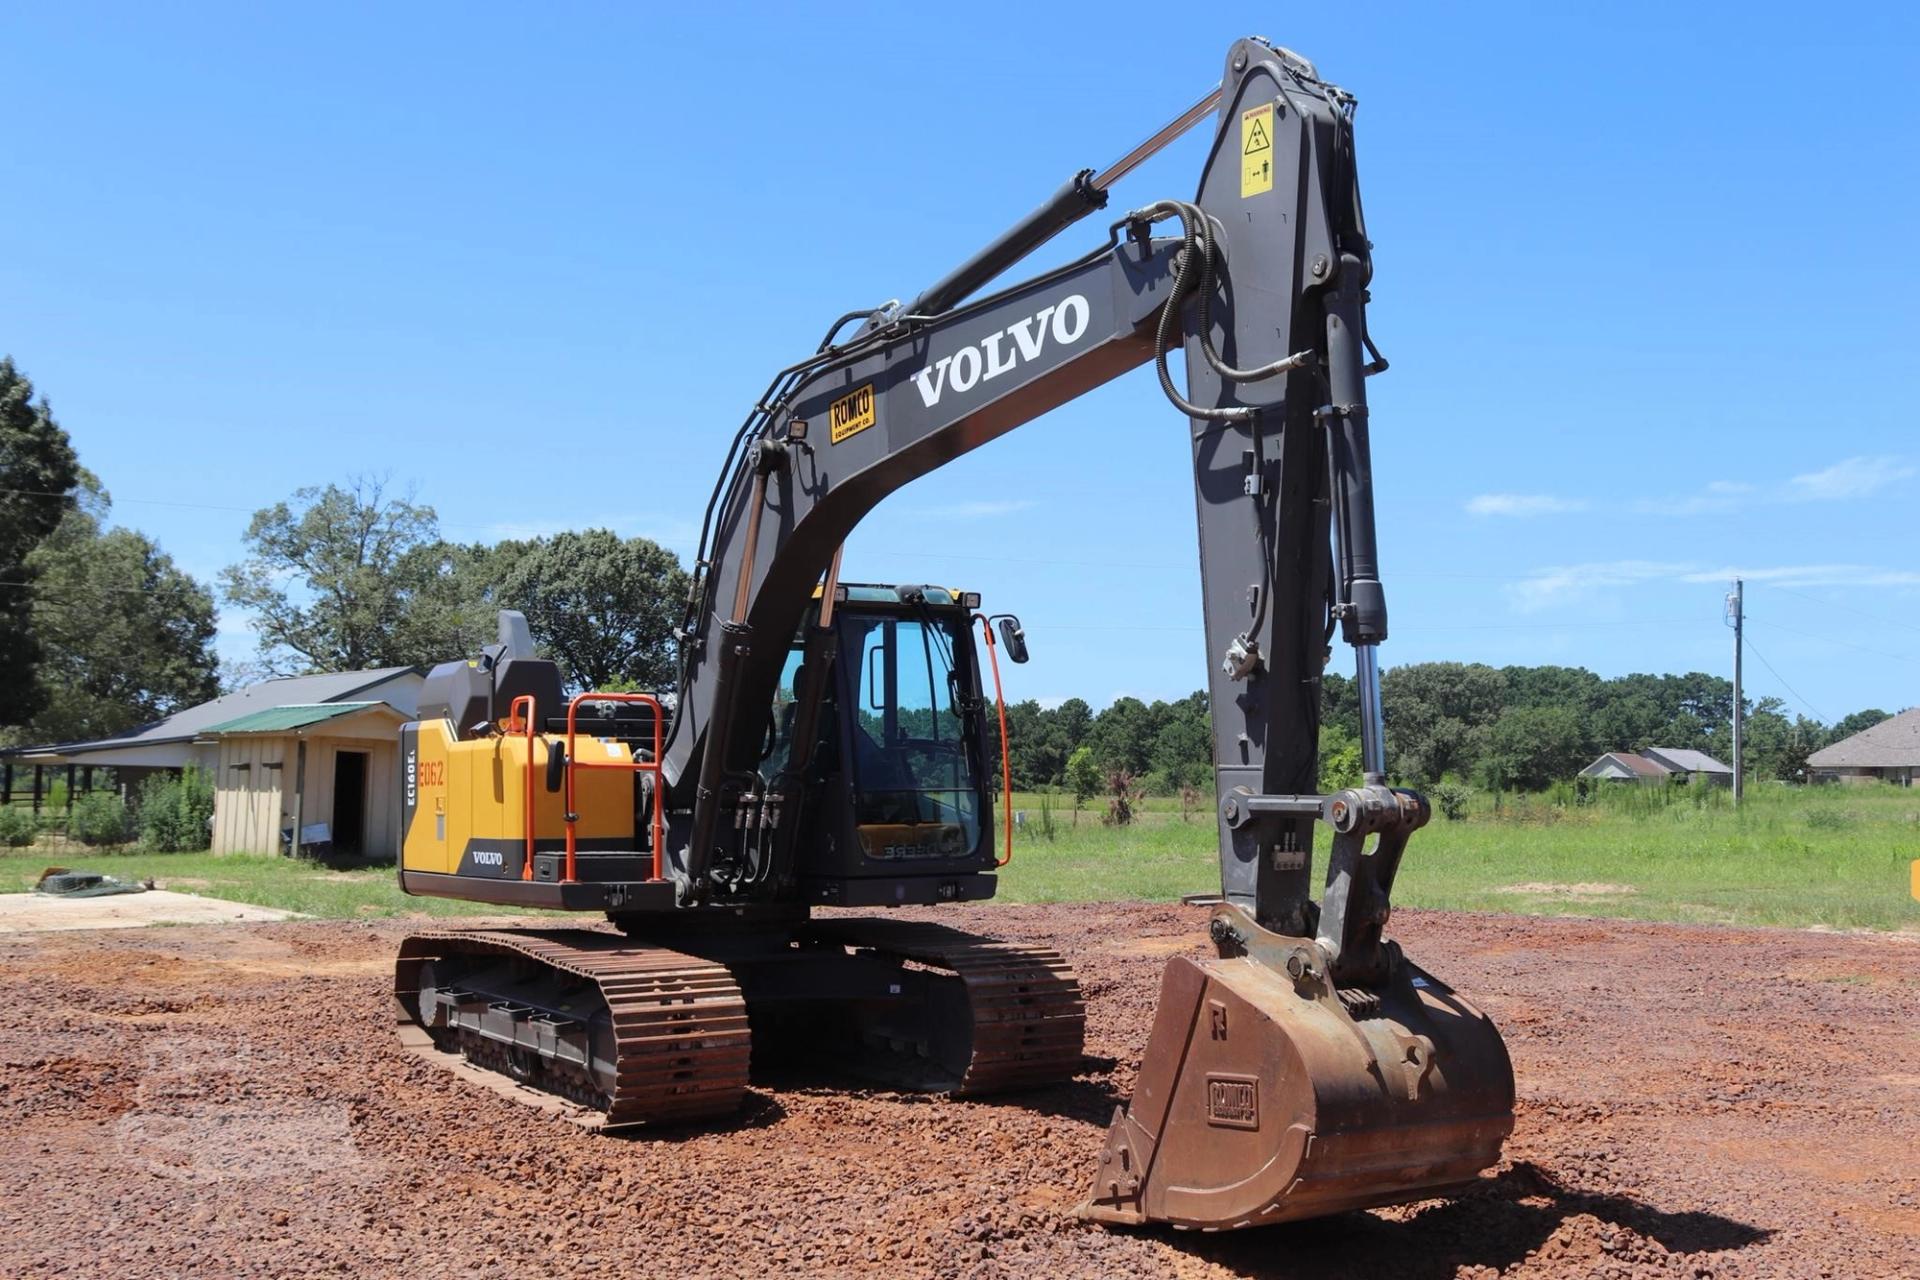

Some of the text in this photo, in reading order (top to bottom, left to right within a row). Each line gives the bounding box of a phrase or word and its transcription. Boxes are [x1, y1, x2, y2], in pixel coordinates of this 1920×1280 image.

[910, 294, 1090, 408] VOLVO
[834, 389, 869, 428] ROMCO
[418, 761, 444, 787] E062
[472, 851, 503, 866] VOLVO
